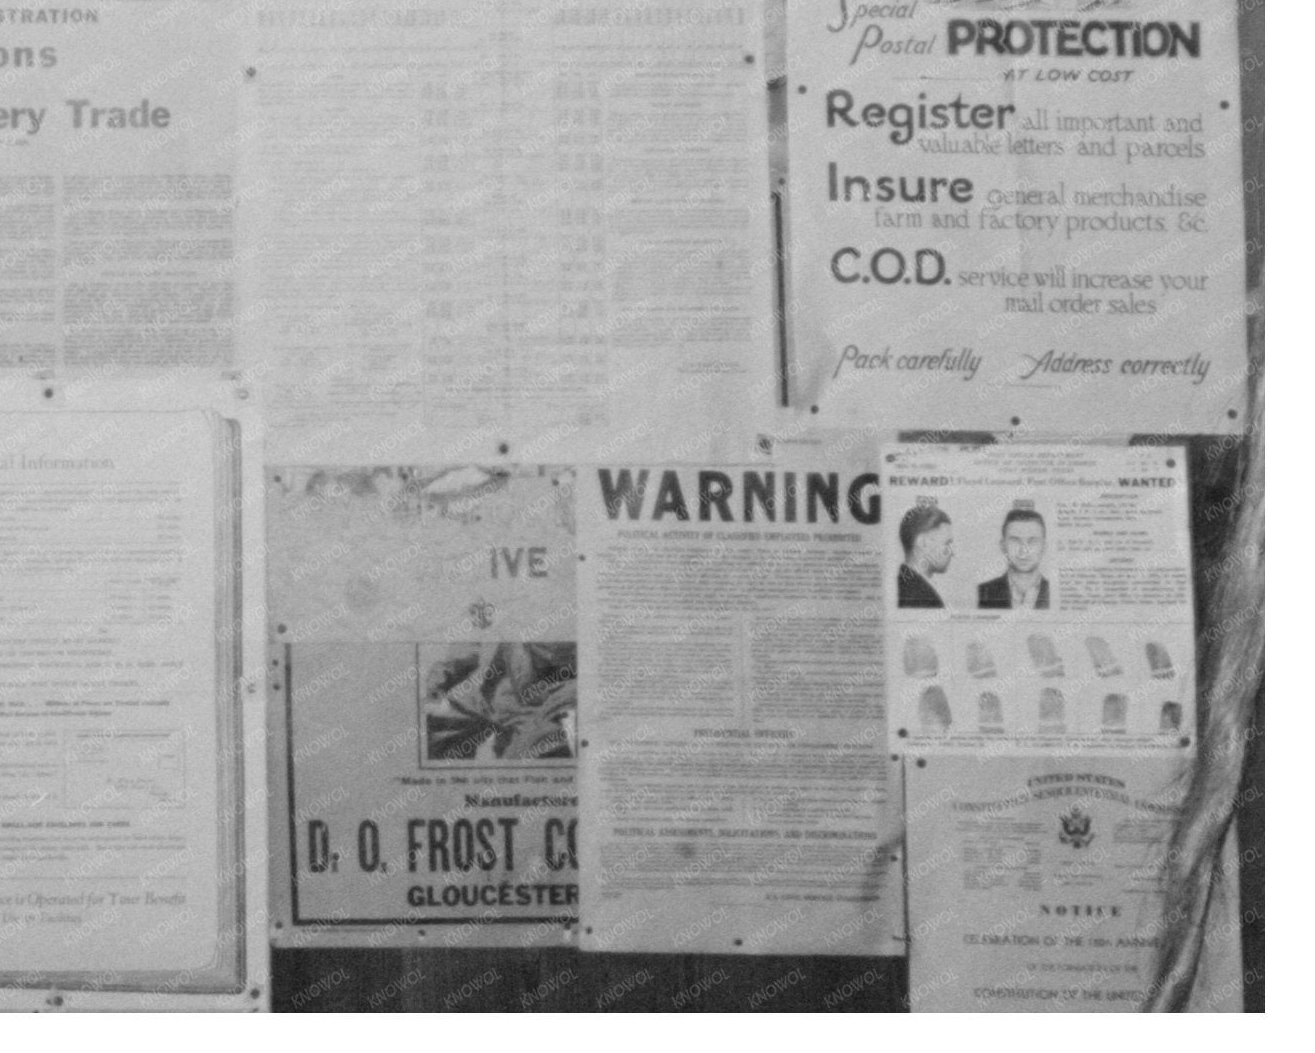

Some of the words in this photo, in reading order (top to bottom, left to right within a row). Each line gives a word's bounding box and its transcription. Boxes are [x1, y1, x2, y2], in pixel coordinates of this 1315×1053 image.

[850, 23, 937, 66] Postal
[947, 18, 1201, 58] PROTECTION
[1002, 69, 1029, 82] AT
[1035, 69, 1082, 83] LOW
[1087, 69, 1135, 83] COST
[66, 98, 171, 129] Trade
[826, 88, 1016, 145] Register
[1055, 111, 1154, 139] important
[917, 134, 1002, 156] valuable
[1007, 135, 1064, 157] letters
[1126, 137, 1206, 164] parcels
[828, 162, 974, 204] Insure
[987, 182, 1064, 211] general
[1073, 183, 1207, 208] merchandise
[873, 208, 923, 229] farm
[978, 208, 1060, 239] factory
[831, 246, 952, 286] C.O.D.
[958, 269, 1029, 288] service
[1073, 268, 1154, 290] increase
[1160, 273, 1209, 296] your
[1005, 293, 1044, 314] mail
[1048, 297, 1101, 314] order
[1108, 295, 1157, 315] sales
[833, 345, 890, 379] Pack
[896, 347, 982, 381] carefully
[1020, 350, 1113, 379] Address
[1120, 353, 1211, 385] correctly
[20, 453, 115, 470] Information
[597, 468, 881, 526] WARNING
[1118, 477, 1176, 487] WANTED
[407, 818, 519, 872] FROST
[408, 881, 579, 907] GLOUCESTER
[1040, 904, 1121, 918] NOTICE
